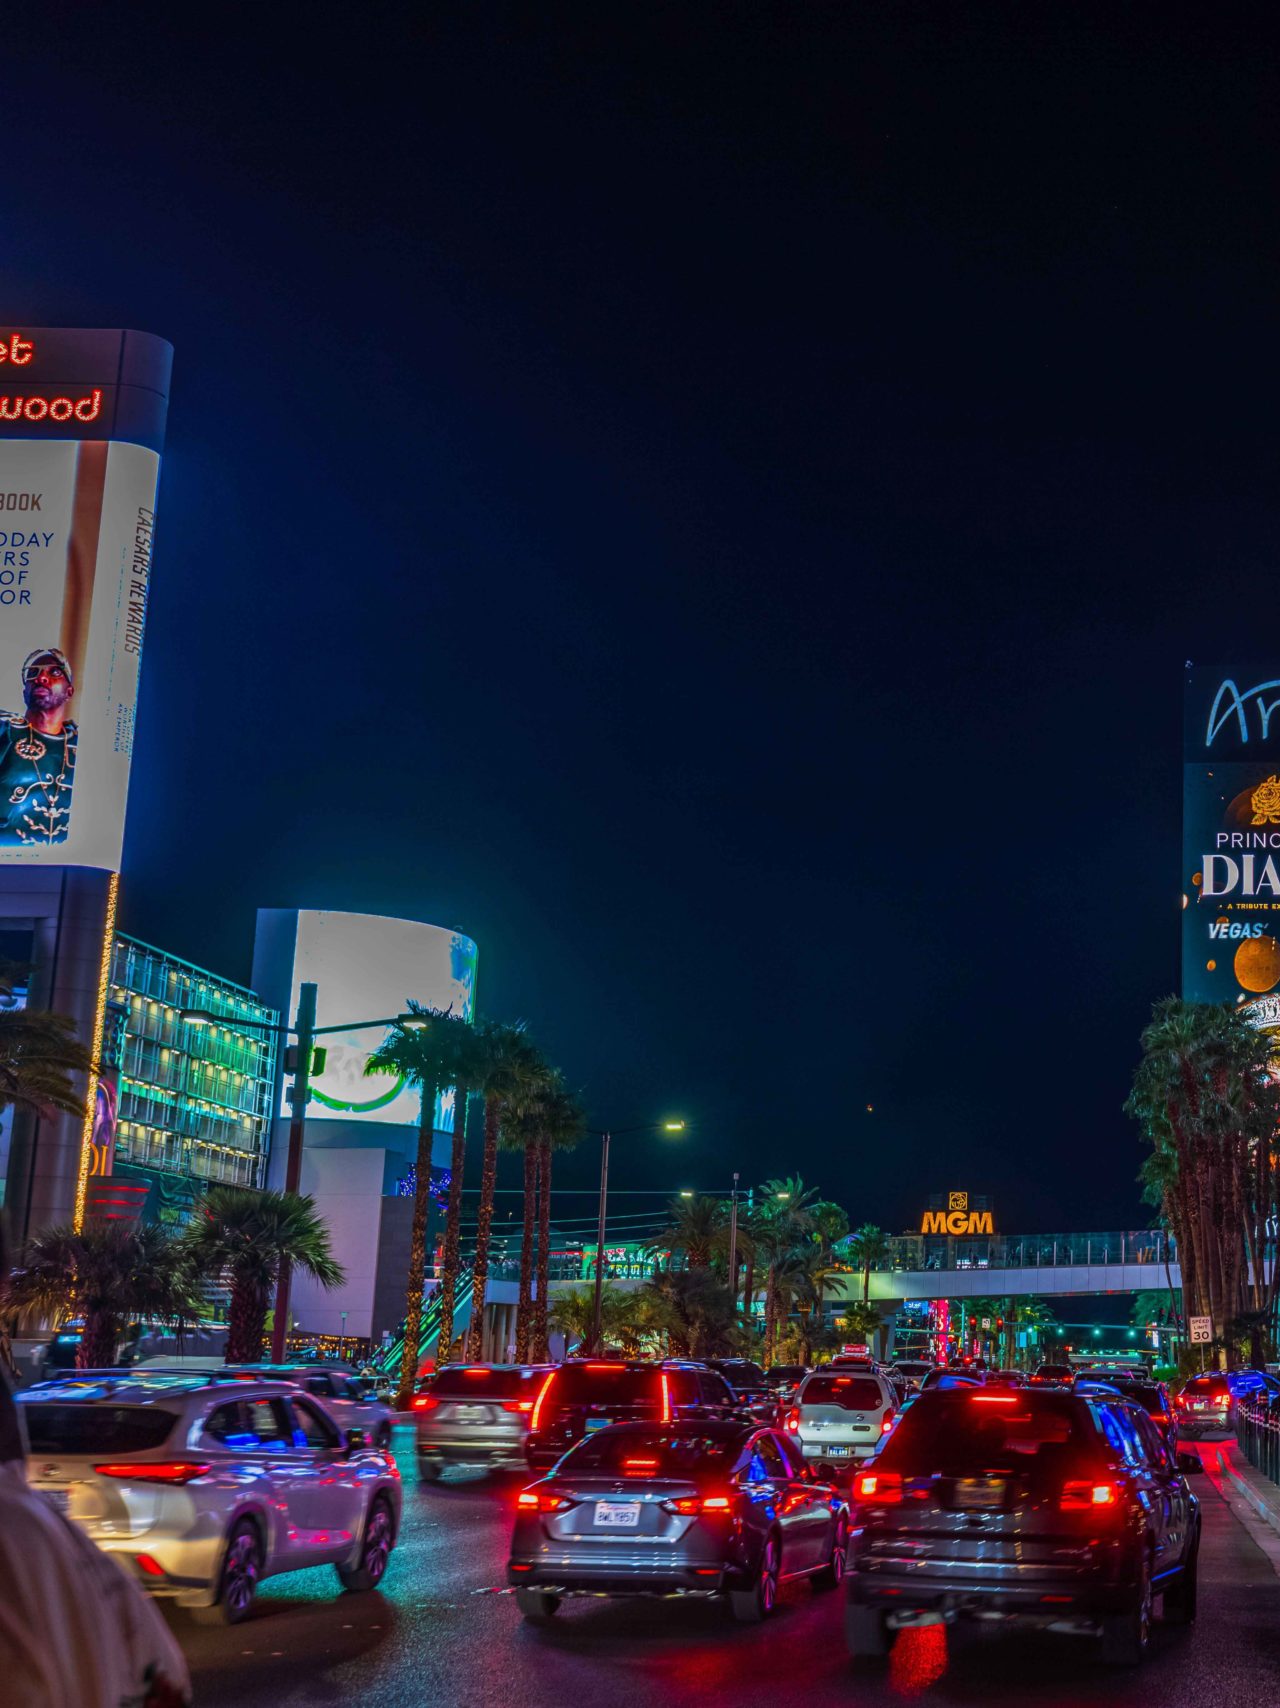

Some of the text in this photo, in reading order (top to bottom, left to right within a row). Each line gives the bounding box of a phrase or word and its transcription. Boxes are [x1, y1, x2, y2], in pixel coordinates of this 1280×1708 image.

[132, 507, 154, 577] CAESARS
[921, 1211, 994, 1235] MGM
[1193, 1331, 1210, 1340] 30
